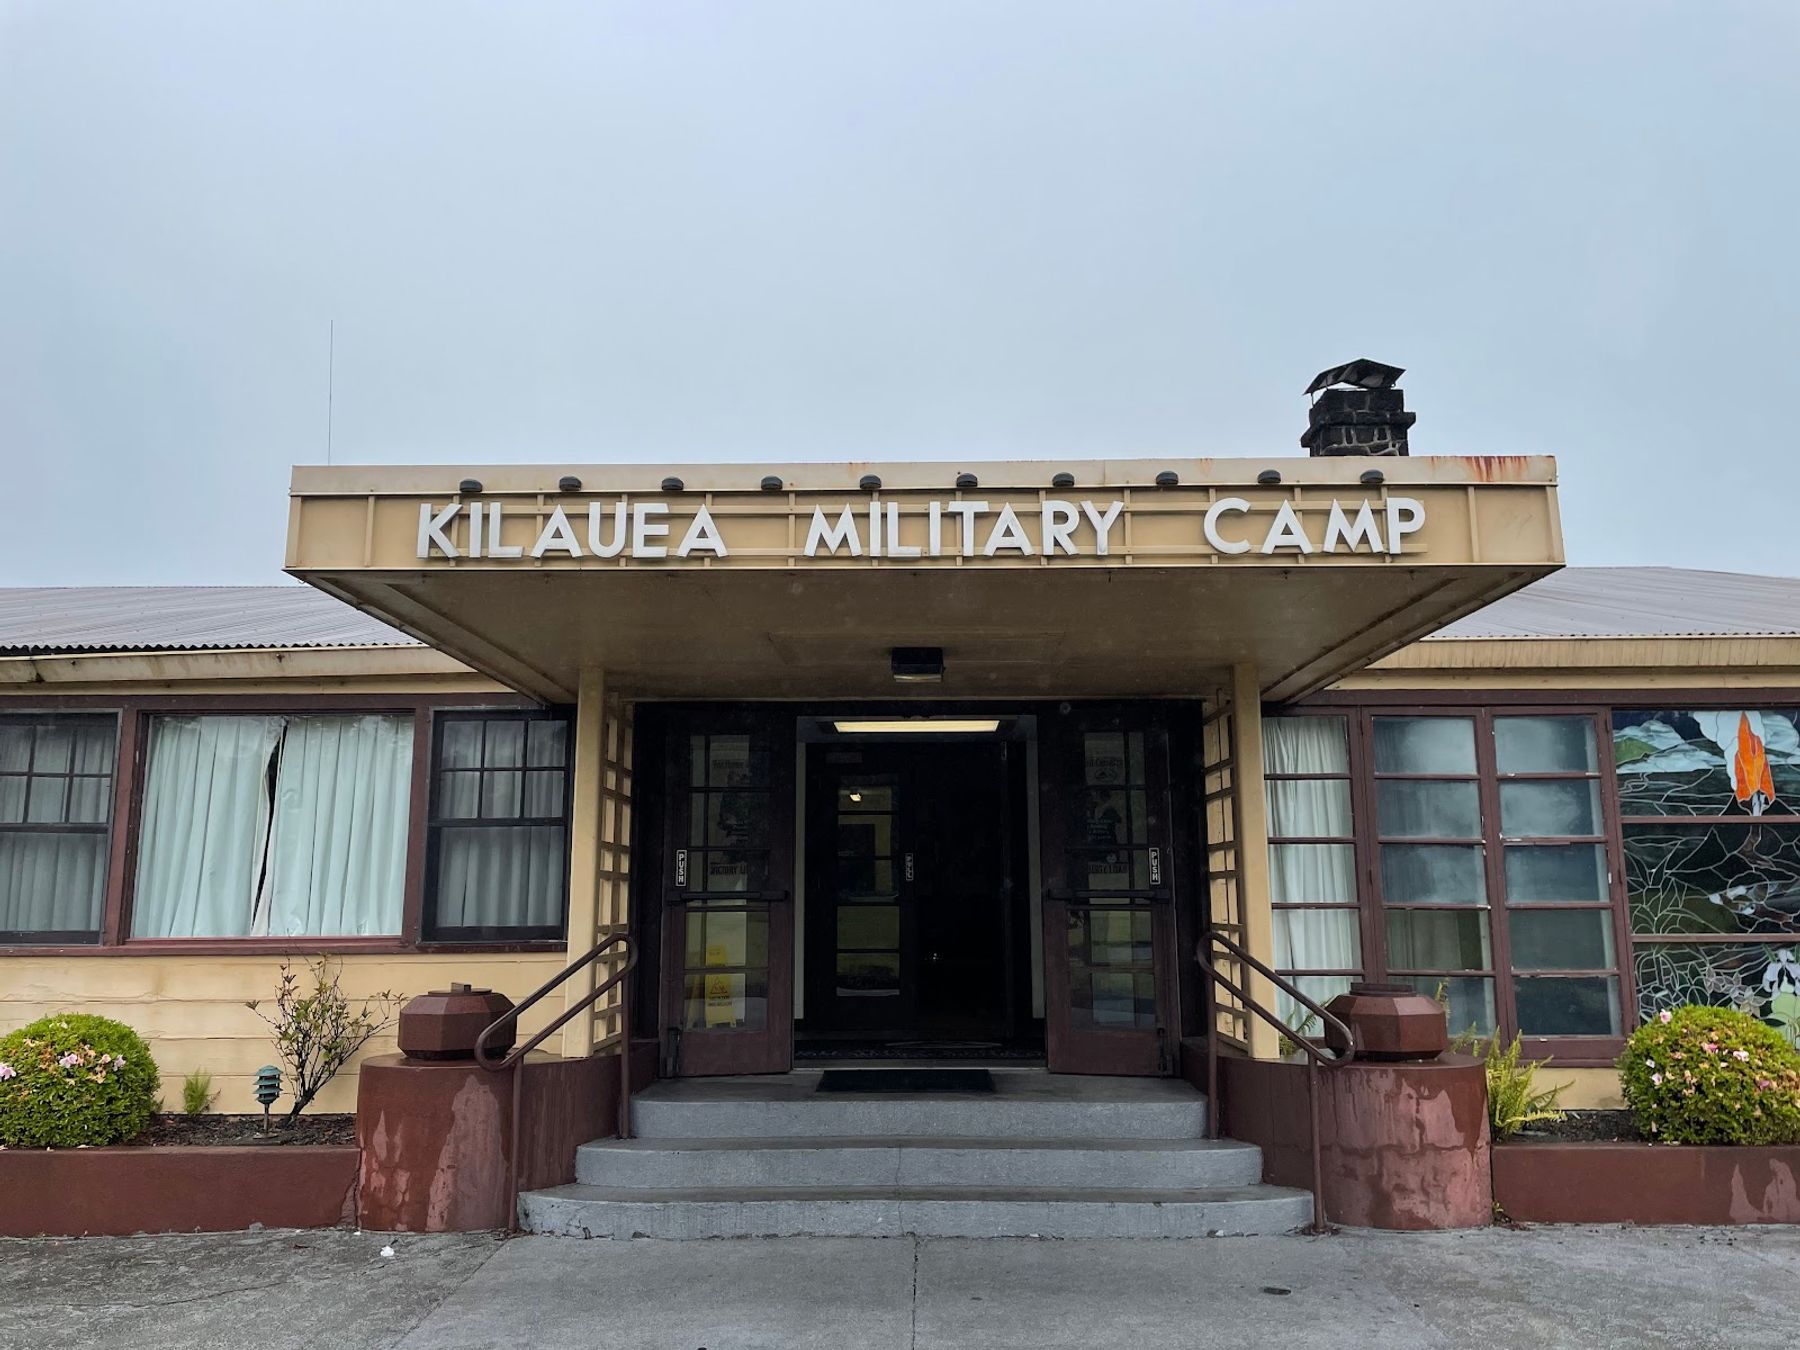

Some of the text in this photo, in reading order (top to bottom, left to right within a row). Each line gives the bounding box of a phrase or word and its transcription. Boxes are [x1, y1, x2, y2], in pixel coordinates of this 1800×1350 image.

[417, 497, 1425, 558] KILAUEA MILITARY CAMP
[1151, 851, 1159, 881] PUSH
